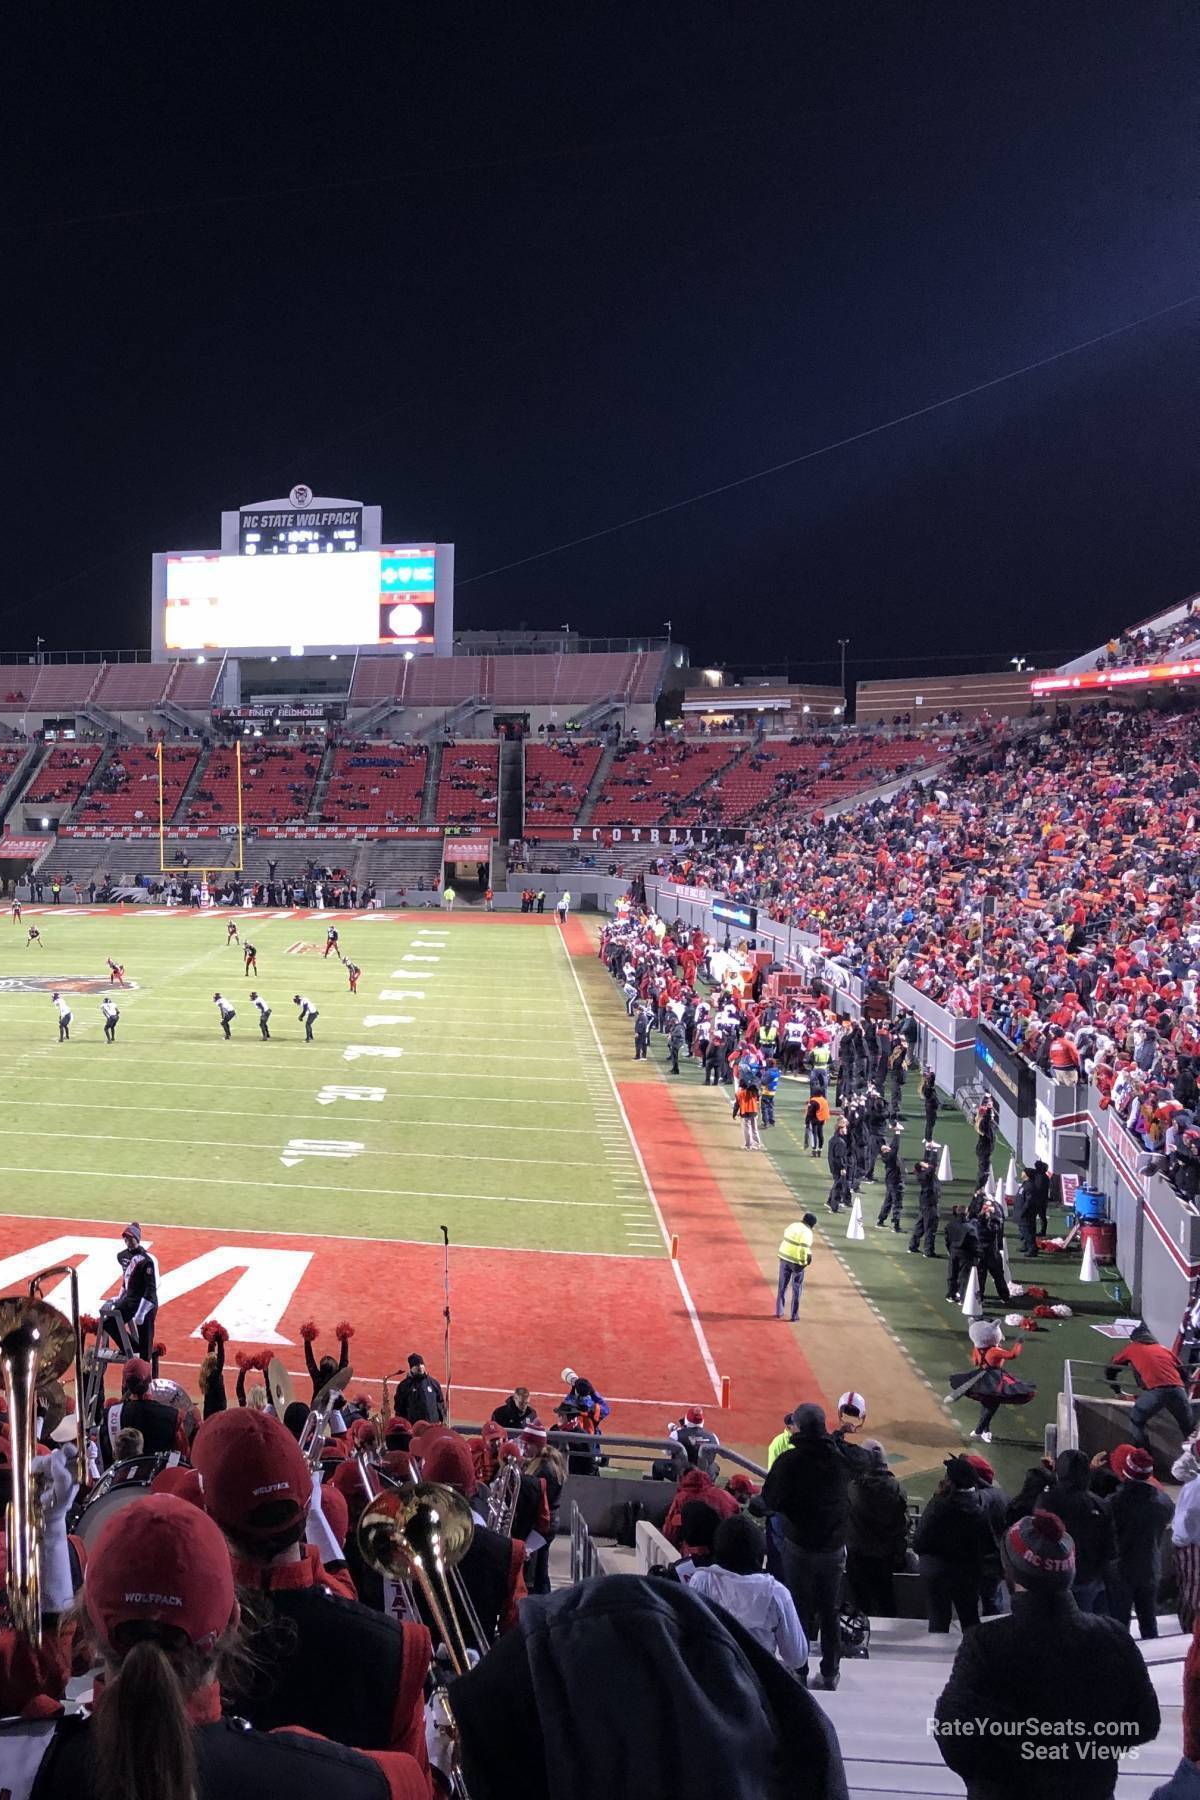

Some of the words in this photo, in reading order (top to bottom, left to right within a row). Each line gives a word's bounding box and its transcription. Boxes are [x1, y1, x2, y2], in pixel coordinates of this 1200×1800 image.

[243, 516, 259, 528] NC
[260, 514, 295, 527] STATE
[296, 512, 359, 526] WOLFPACK
[248, 708, 273, 717] FINLEY
[278, 708, 324, 717] FIELDHOUSE
[121, 910, 400, 921] STATE
[125, 1592, 184, 1608] WOLFPACK
